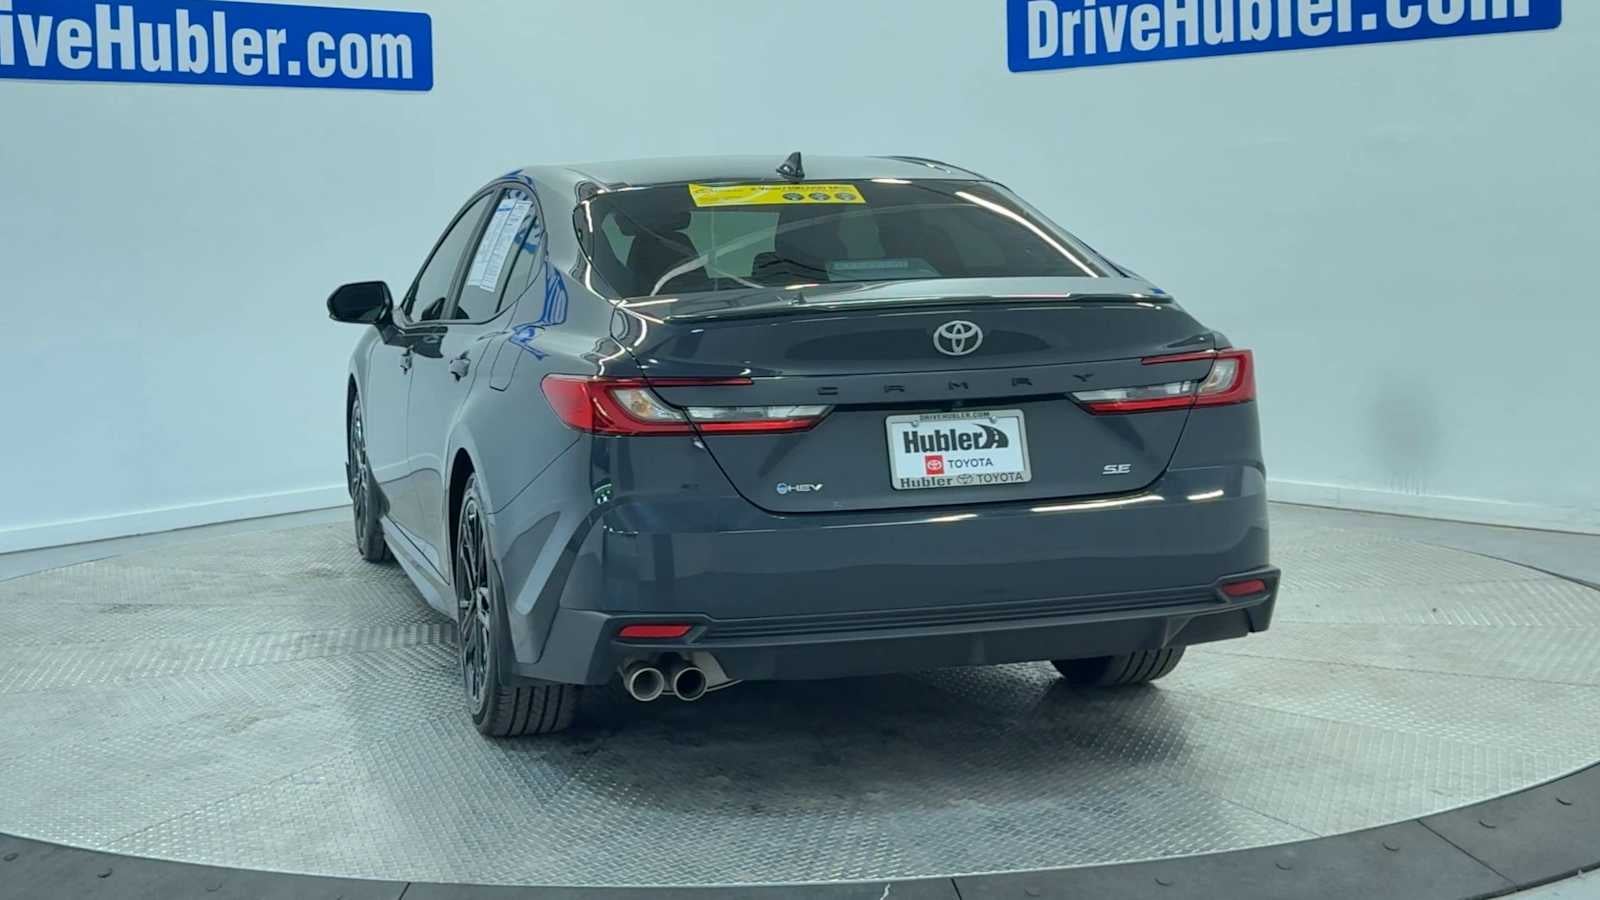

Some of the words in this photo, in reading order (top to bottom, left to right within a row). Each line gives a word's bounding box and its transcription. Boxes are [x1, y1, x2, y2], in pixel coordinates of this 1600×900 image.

[817, 373, 1094, 396] CAMRY
[903, 428, 983, 453] Hubler
[948, 457, 994, 469] TOYOTA
[1102, 463, 1132, 475] SE
[900, 477, 953, 488] Hubler
[977, 472, 1024, 483] TOYOTA
